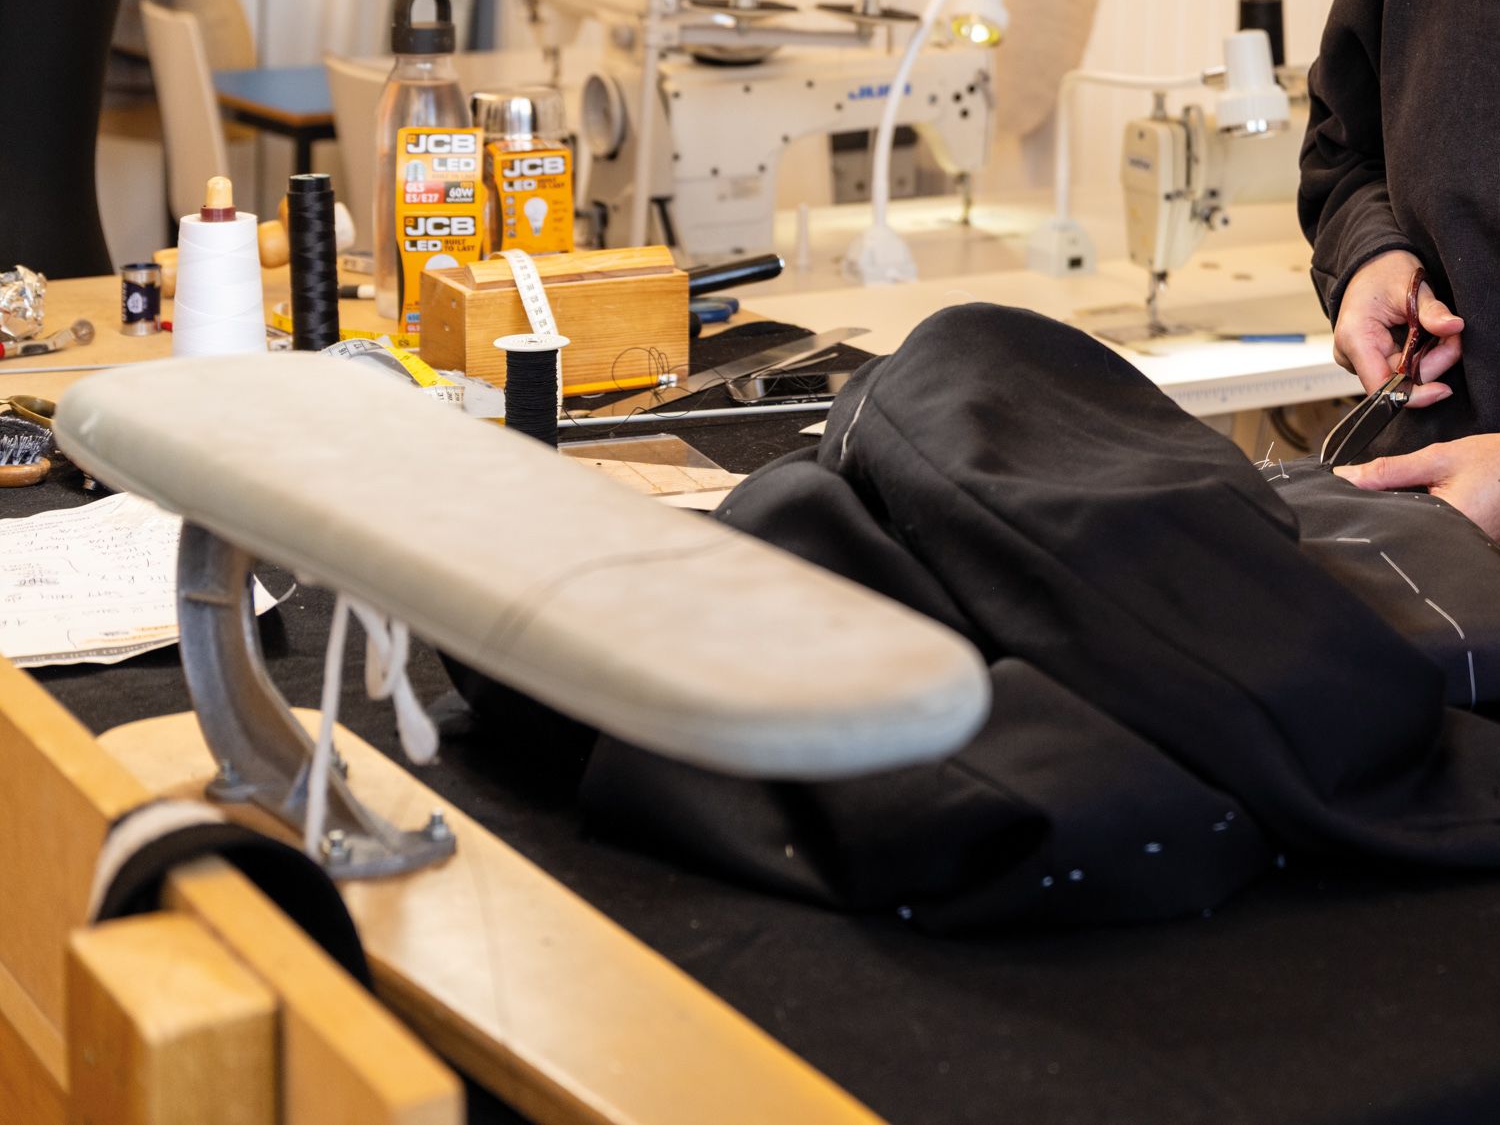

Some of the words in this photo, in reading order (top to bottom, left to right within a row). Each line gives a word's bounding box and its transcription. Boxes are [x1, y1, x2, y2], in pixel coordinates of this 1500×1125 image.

[406, 133, 476, 153] JCB
[432, 158, 476, 172] LED
[503, 156, 565, 177] JCB
[449, 187, 474, 198] 60W
[503, 179, 538, 192] LED
[405, 216, 476, 236] JCB
[404, 239, 443, 252] LED
